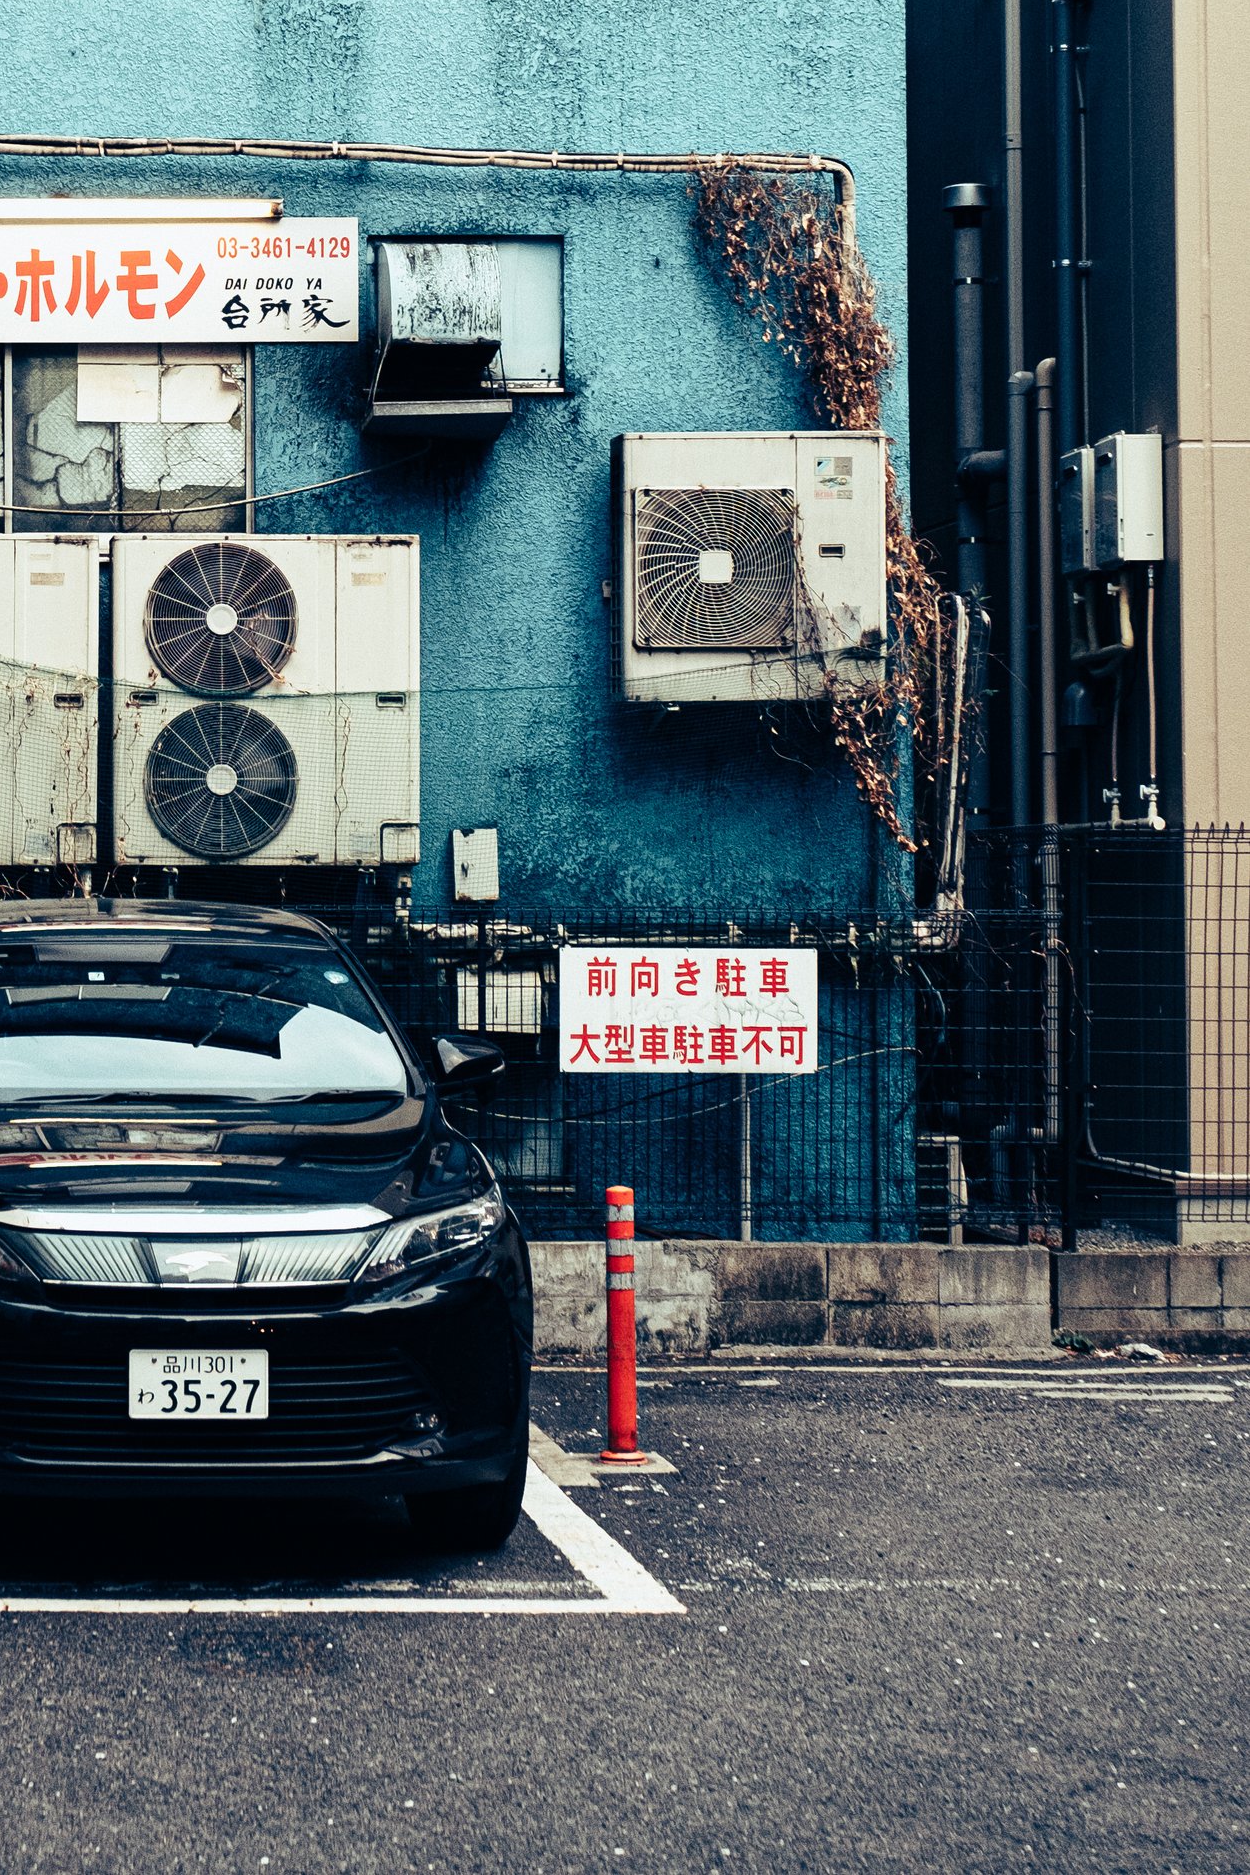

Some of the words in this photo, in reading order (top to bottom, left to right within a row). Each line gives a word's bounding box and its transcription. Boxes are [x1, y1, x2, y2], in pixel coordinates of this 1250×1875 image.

[216, 236, 352, 260] 03-3461-4129
[224, 278, 248, 291] DAI
[255, 278, 295, 291] DOKO
[305, 278, 324, 291] YA
[220, 293, 352, 335] 台所家
[586, 955, 790, 998] 前向き駐車
[569, 1023, 809, 1066] 大型車駐車不可
[162, 1355, 234, 1374] 品川301
[137, 1388, 155, 1405] わ
[160, 1379, 261, 1414] 35-27
